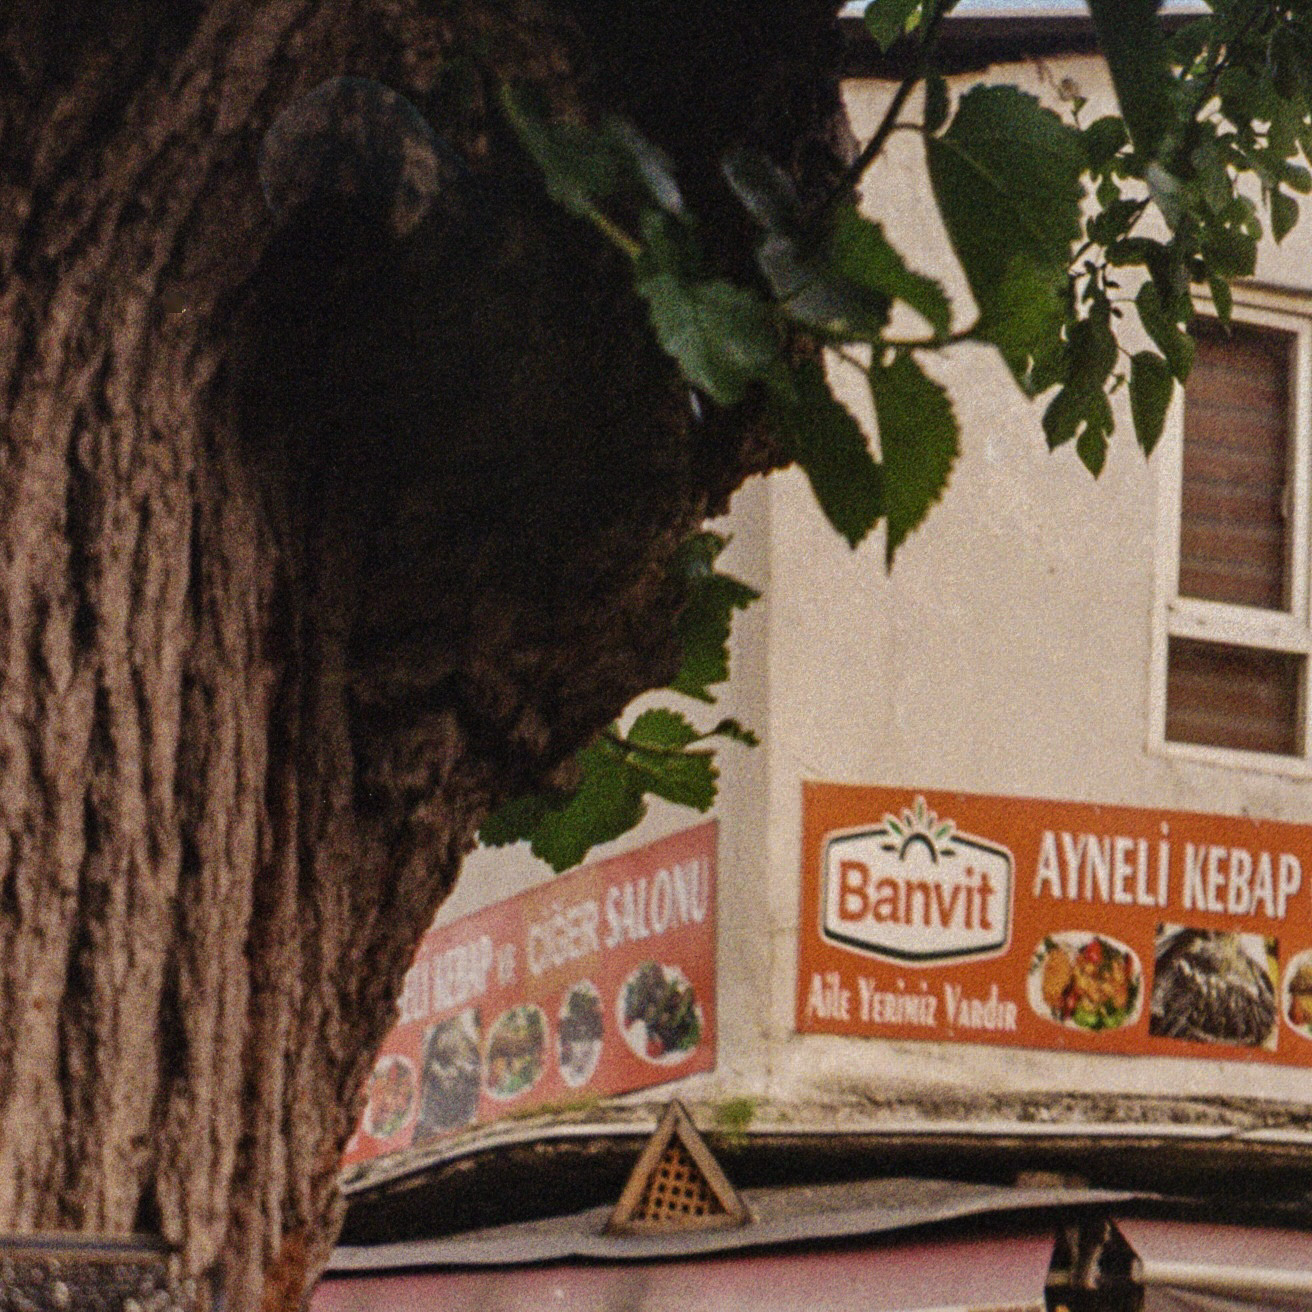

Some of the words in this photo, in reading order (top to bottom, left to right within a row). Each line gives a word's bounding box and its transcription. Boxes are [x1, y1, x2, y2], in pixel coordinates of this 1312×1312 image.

[603, 856, 710, 949] SALONU
[837, 858, 995, 932] Banvit
[1032, 820, 1171, 908] AYNELİ
[1181, 840, 1302, 919] KEBAP
